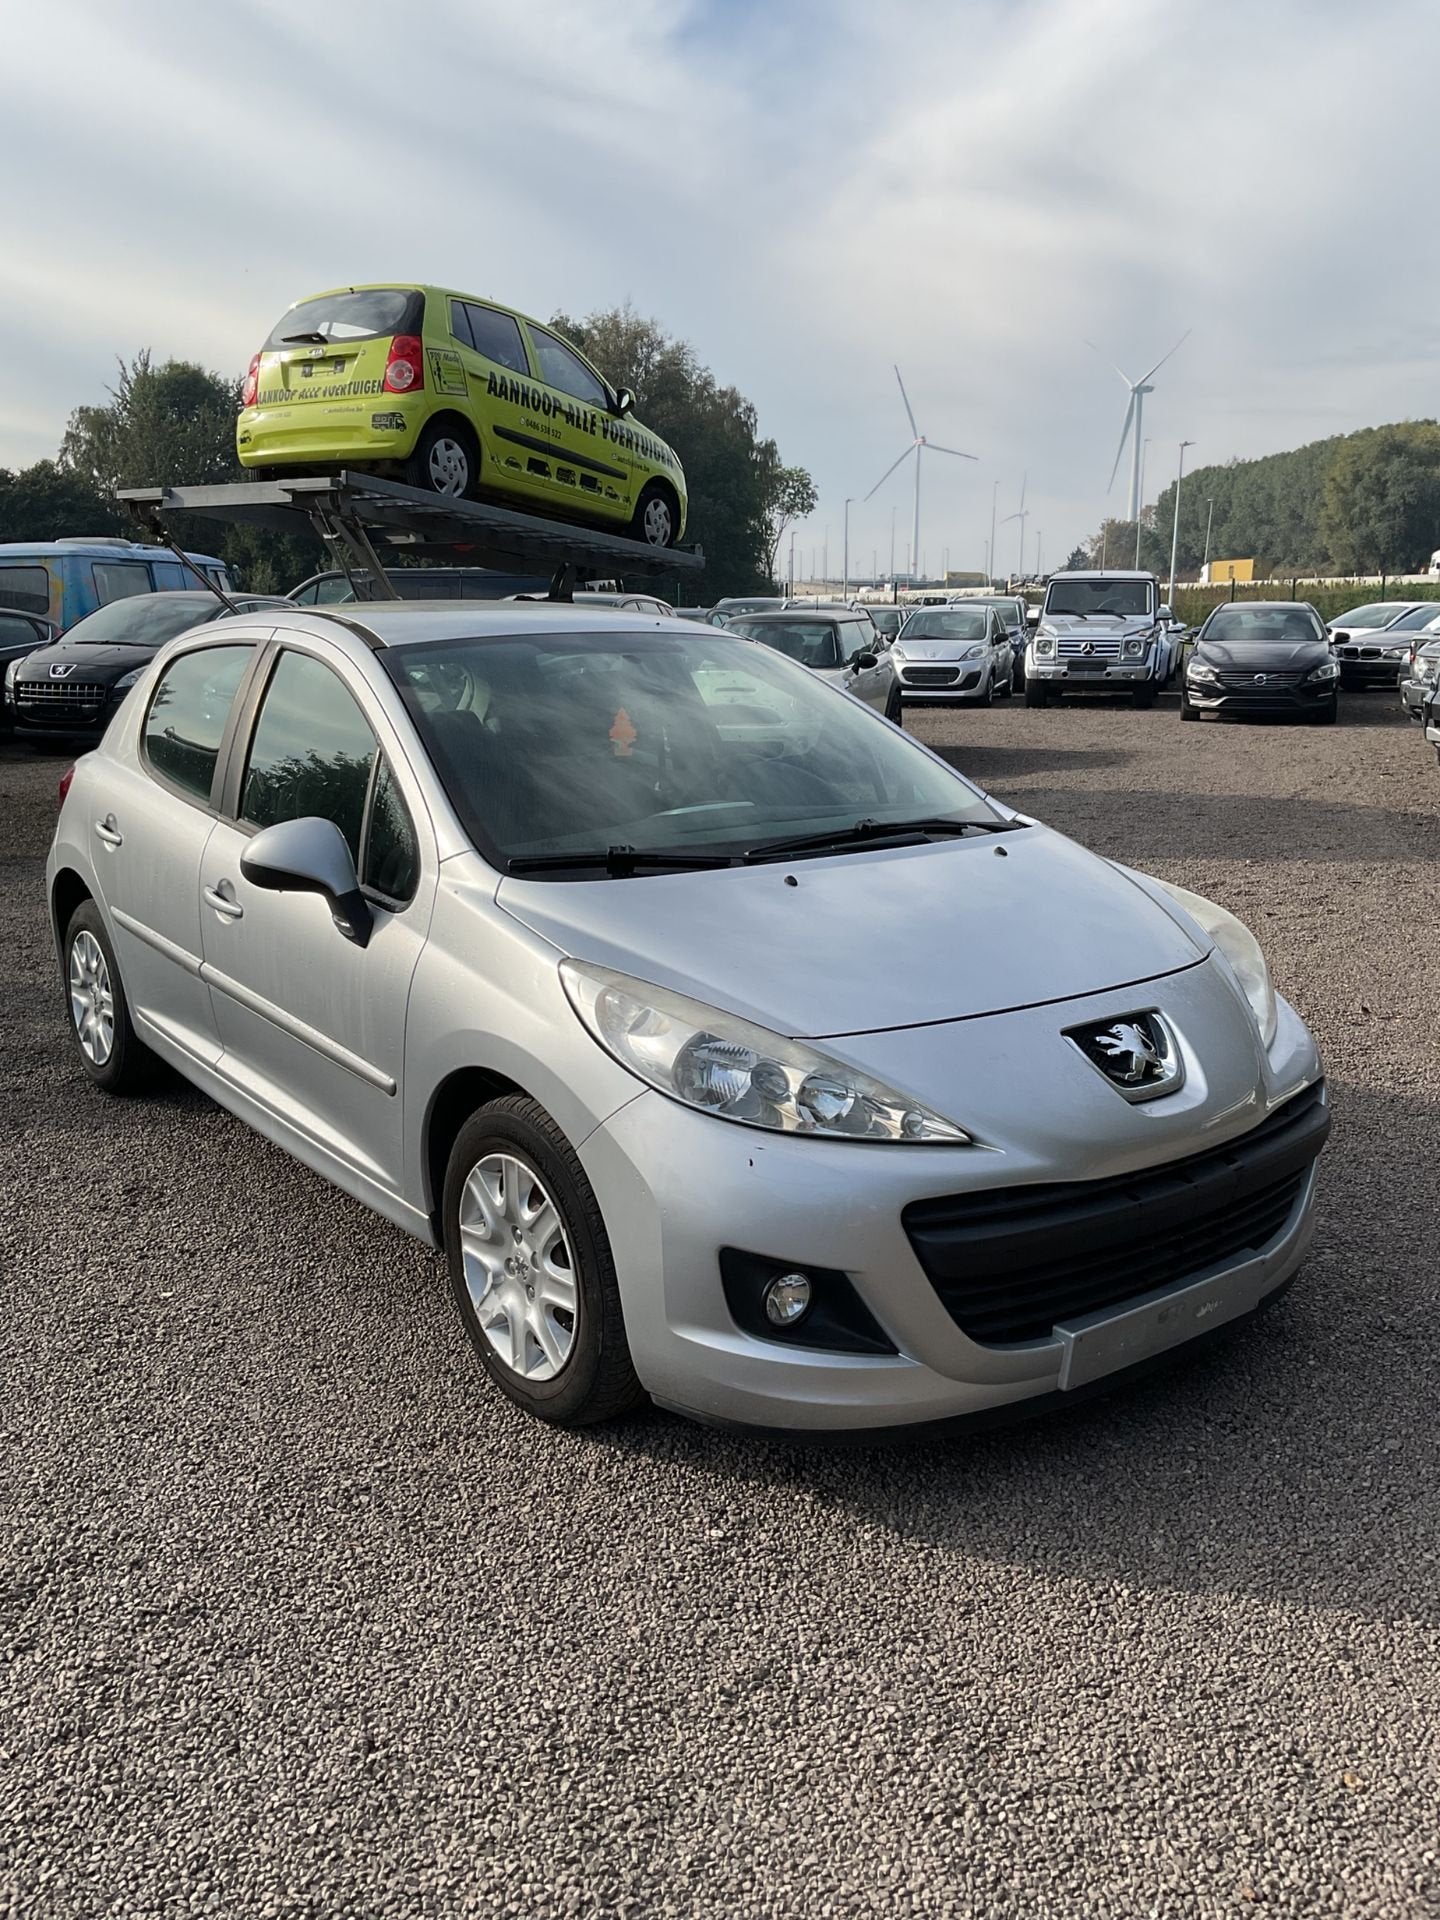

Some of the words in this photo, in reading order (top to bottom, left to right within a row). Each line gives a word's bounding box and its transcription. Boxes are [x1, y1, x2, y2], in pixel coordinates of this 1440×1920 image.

[258, 388, 297, 405] AANKOOP
[323, 379, 385, 398] VOERTUIGEN
[486, 371, 562, 420] AANKOOP
[565, 402, 597, 436] ALLE
[601, 416, 674, 469] VOERTUIGEN
